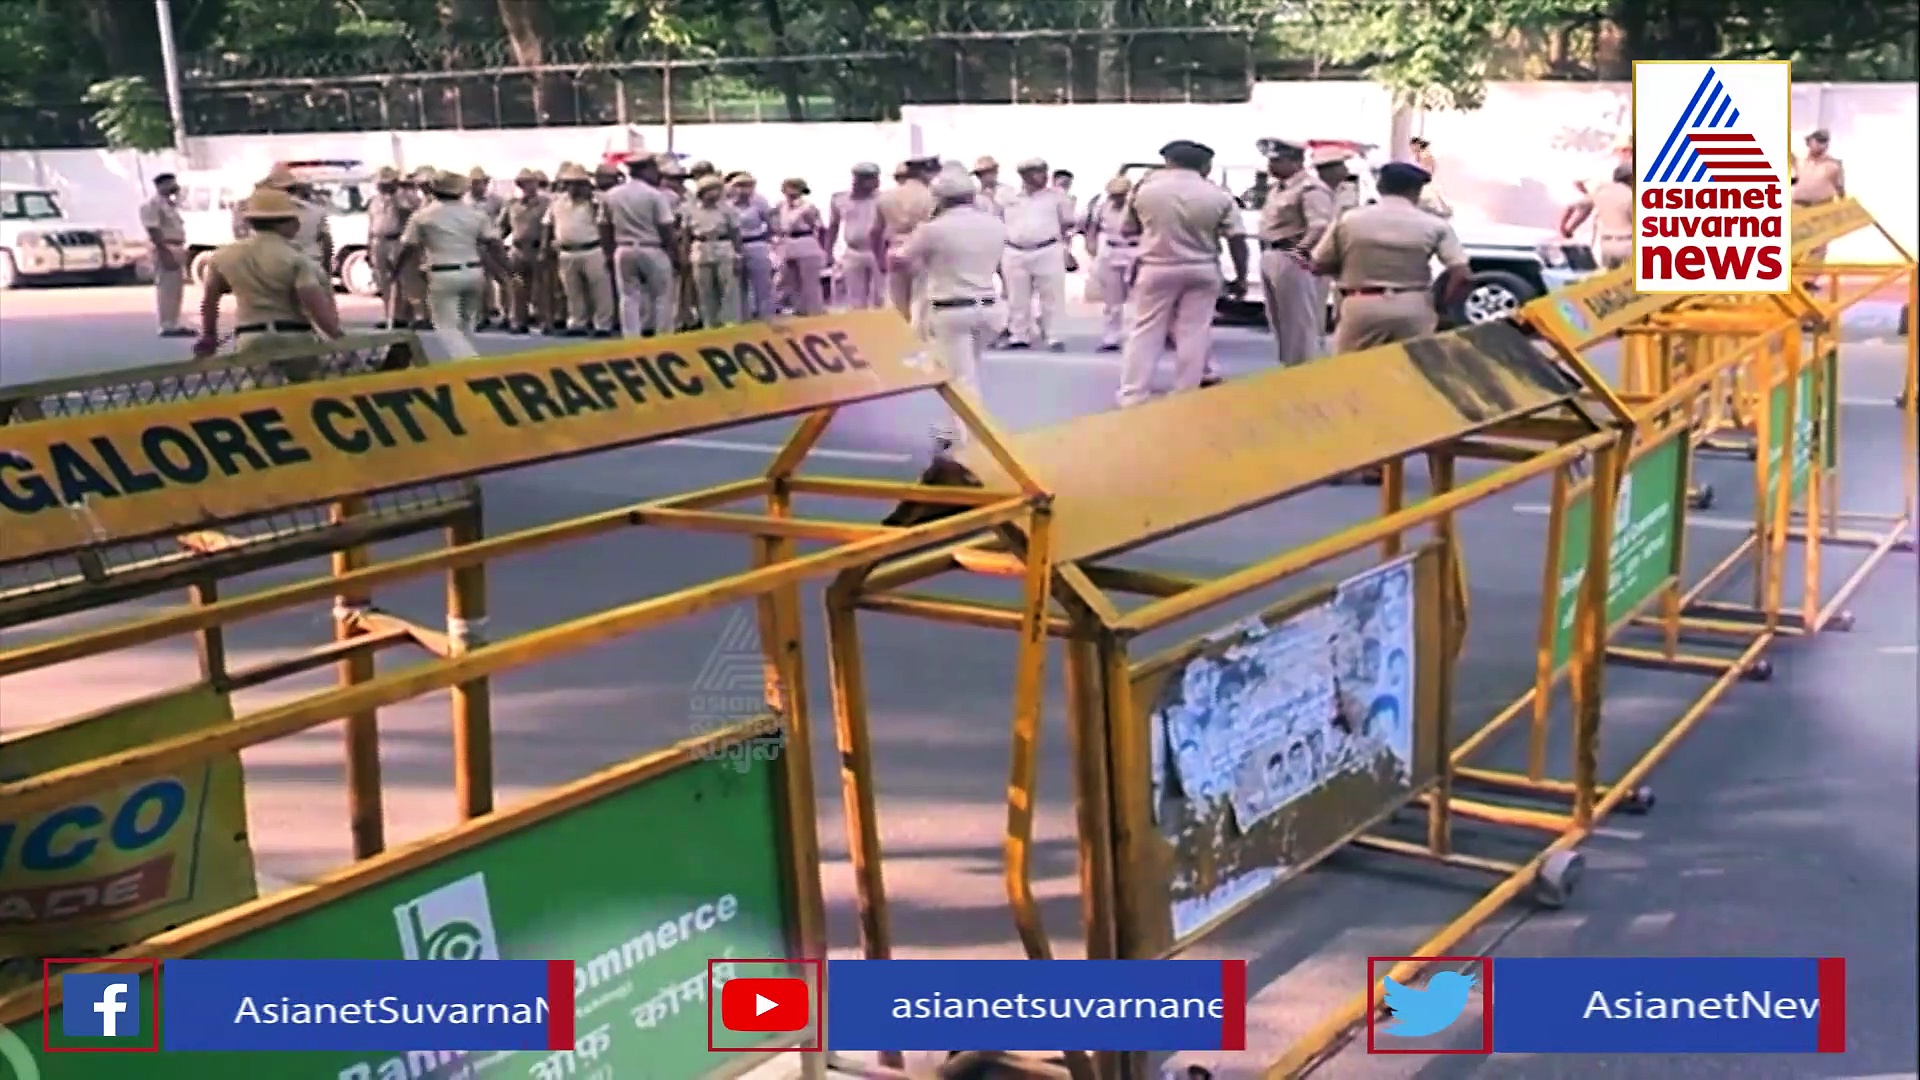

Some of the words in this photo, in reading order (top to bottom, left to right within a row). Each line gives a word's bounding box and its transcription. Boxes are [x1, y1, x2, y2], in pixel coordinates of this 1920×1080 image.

[311, 382, 468, 455] CITY
[467, 350, 706, 430] TRAFFIC
[701, 329, 871, 390] POLICE
[575, 893, 739, 996] ommerce
